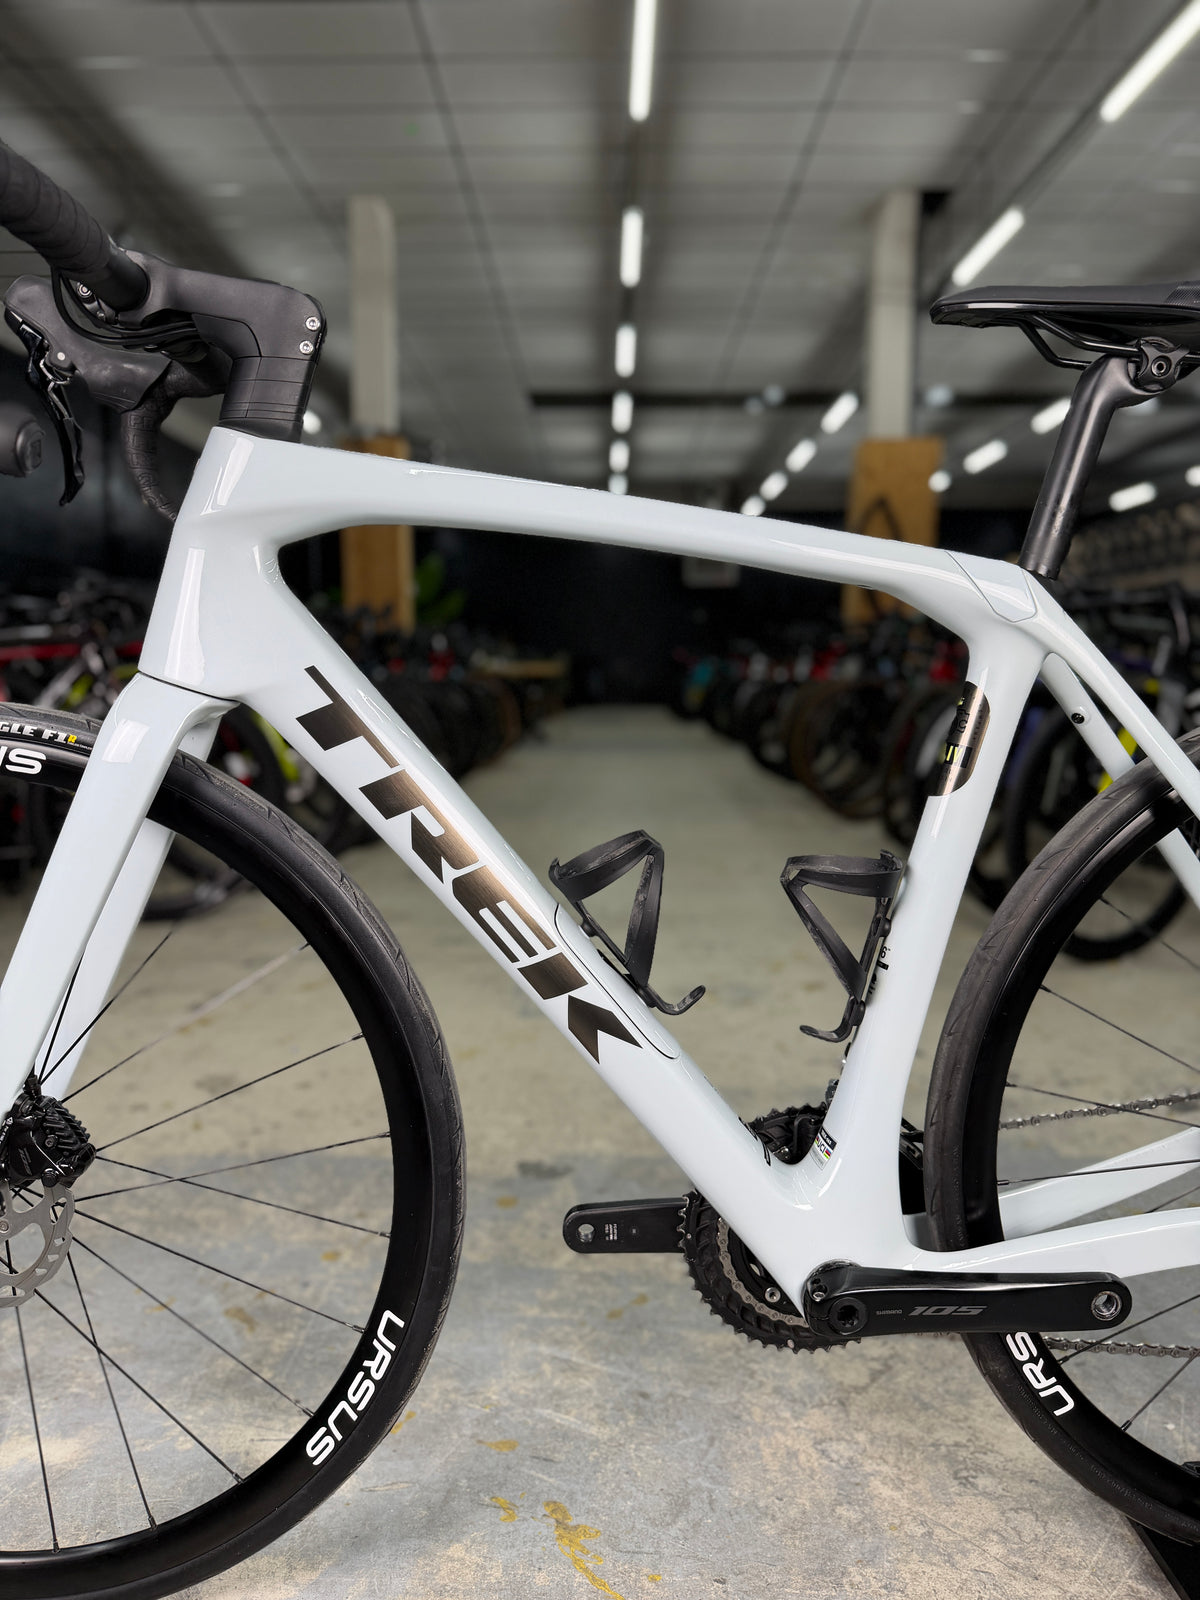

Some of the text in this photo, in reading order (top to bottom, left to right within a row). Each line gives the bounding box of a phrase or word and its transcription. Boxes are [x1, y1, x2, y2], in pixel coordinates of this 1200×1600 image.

[296, 664, 643, 1065] TREK
[908, 1305, 988, 1316] 105
[305, 1309, 405, 1466] URSUS
[1006, 1331, 1075, 1417] URS
